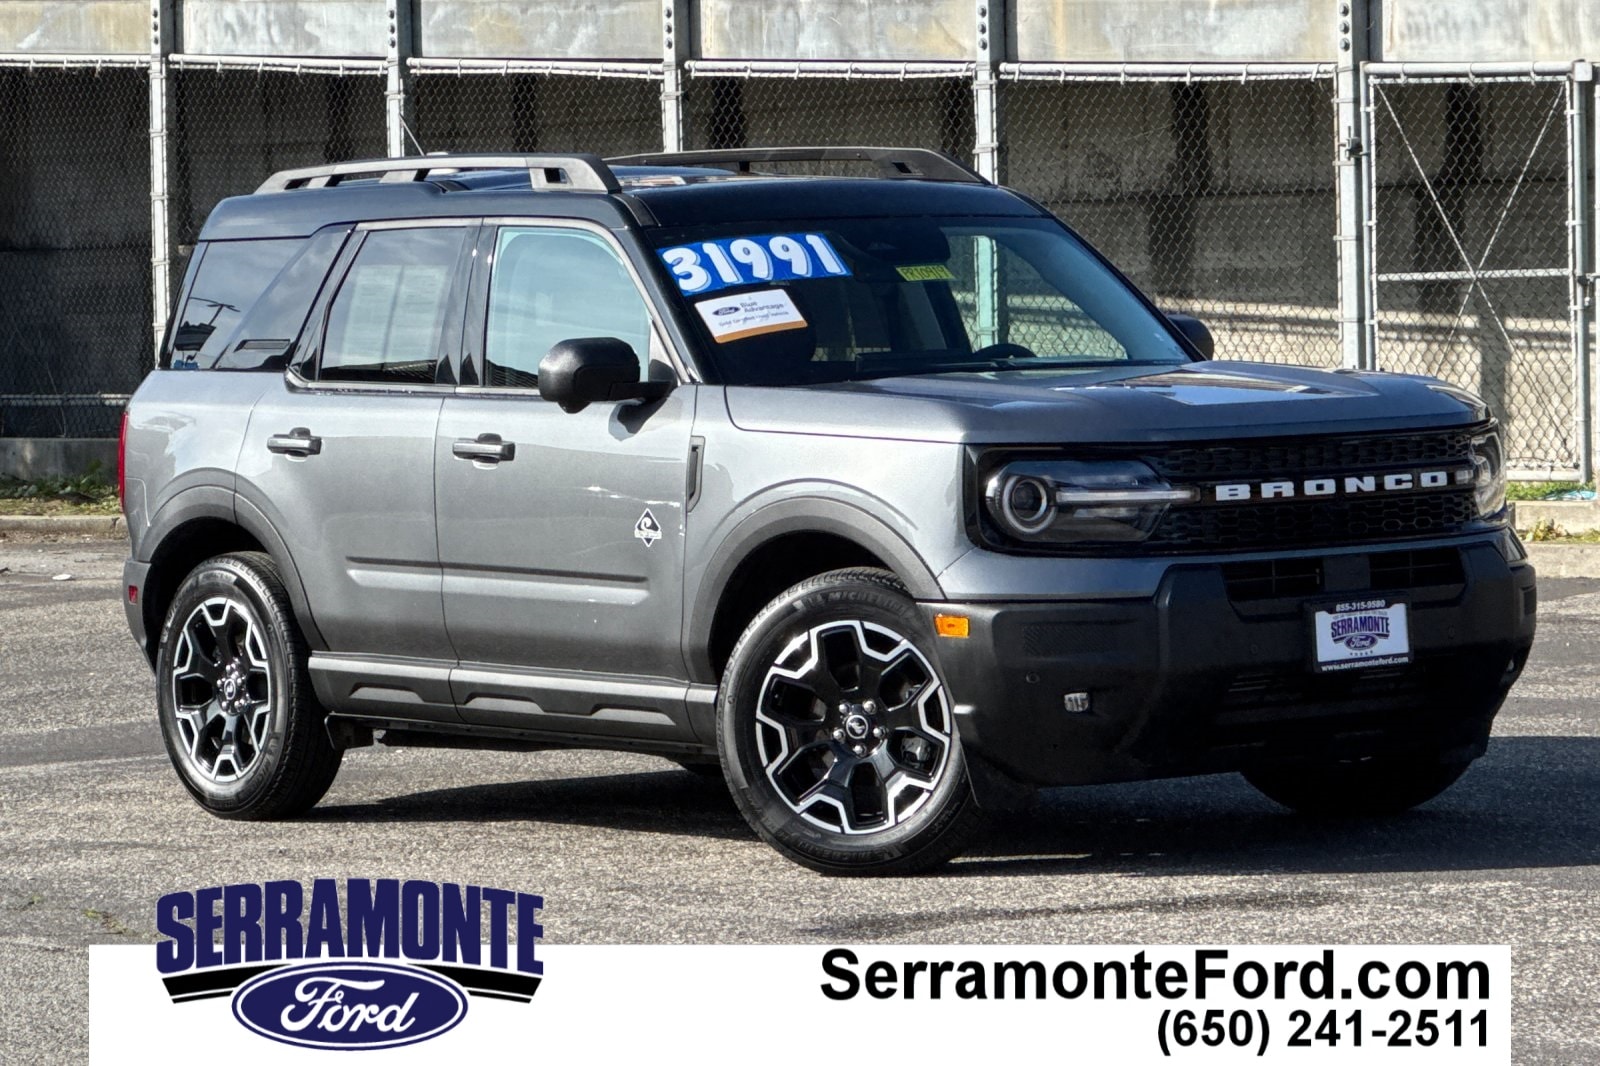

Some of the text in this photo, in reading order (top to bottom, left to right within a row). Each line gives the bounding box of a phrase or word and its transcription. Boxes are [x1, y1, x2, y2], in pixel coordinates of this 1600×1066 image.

[662, 234, 847, 293] 31991
[1215, 471, 1447, 501] BRONCO
[1331, 616, 1390, 639] SERRAMONTE
[1349, 636, 1371, 648] Ford
[1321, 656, 1409, 672] www.serramonteford.com
